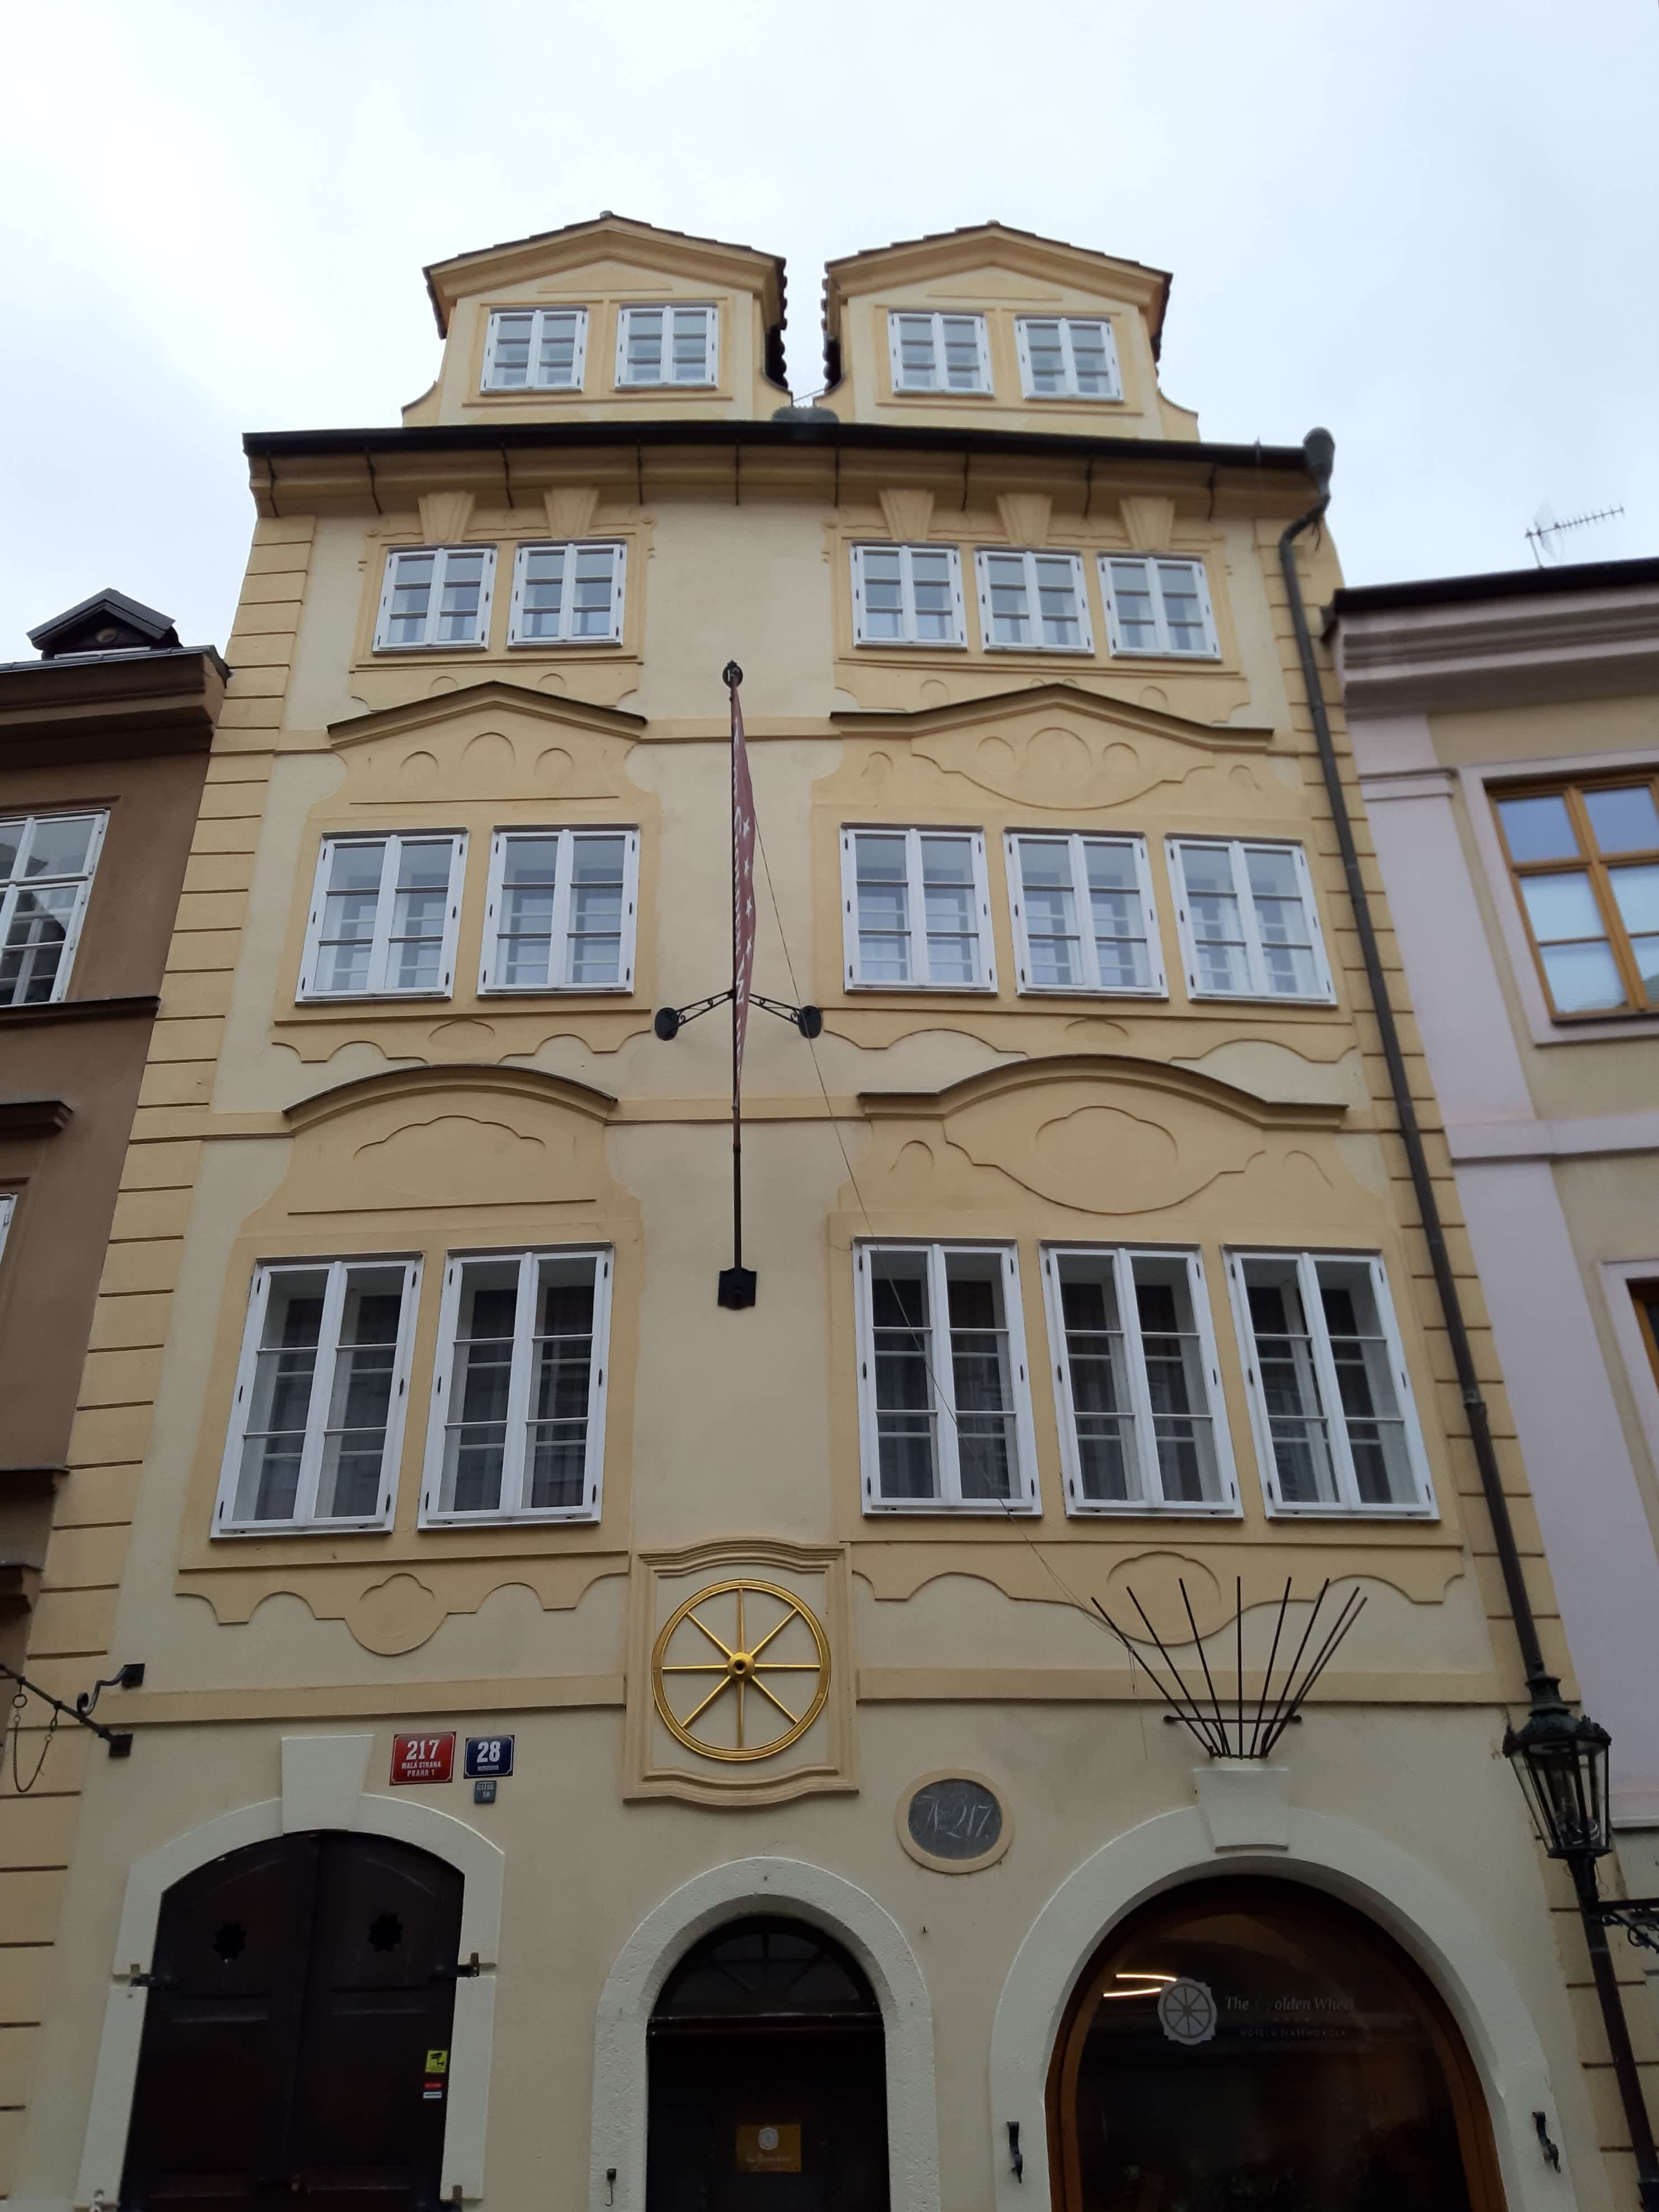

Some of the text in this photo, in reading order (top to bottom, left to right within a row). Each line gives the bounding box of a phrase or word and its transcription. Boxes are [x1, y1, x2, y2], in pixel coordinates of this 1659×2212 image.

[406, 1739, 440, 1760] 217
[476, 1741, 501, 1763] 28
[401, 1760, 418, 1769] MALÁ
[1225, 1996, 1355, 2014] The olden Wheel
